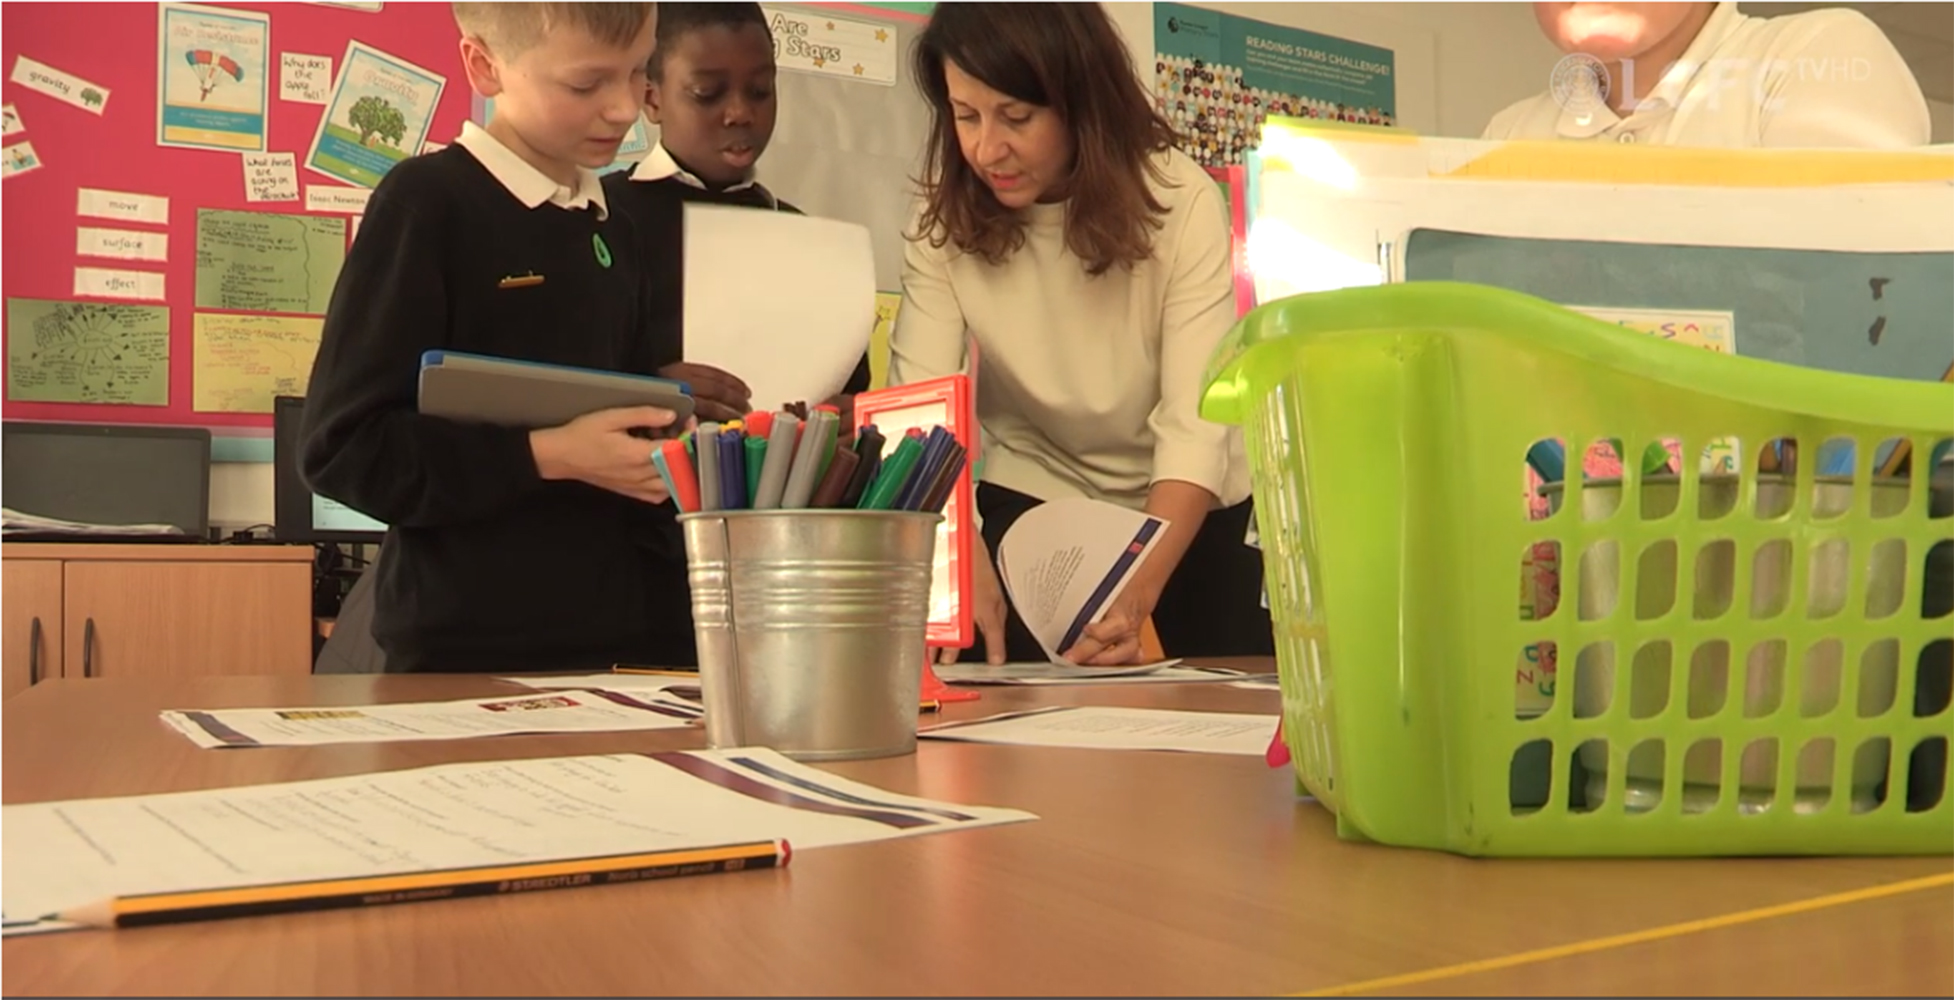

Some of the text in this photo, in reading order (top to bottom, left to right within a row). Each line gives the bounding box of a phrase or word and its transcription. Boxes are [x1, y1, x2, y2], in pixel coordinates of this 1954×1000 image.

[772, 14, 808, 35] Are
[788, 37, 841, 62] Stars
[1246, 35, 1294, 55] READING
[1295, 46, 1328, 63] STARS
[283, 57, 305, 69] Why
[294, 70, 313, 80] the
[29, 71, 71, 95] gravity
[109, 201, 138, 211] move
[103, 237, 142, 251] surface
[105, 278, 135, 291] effect
